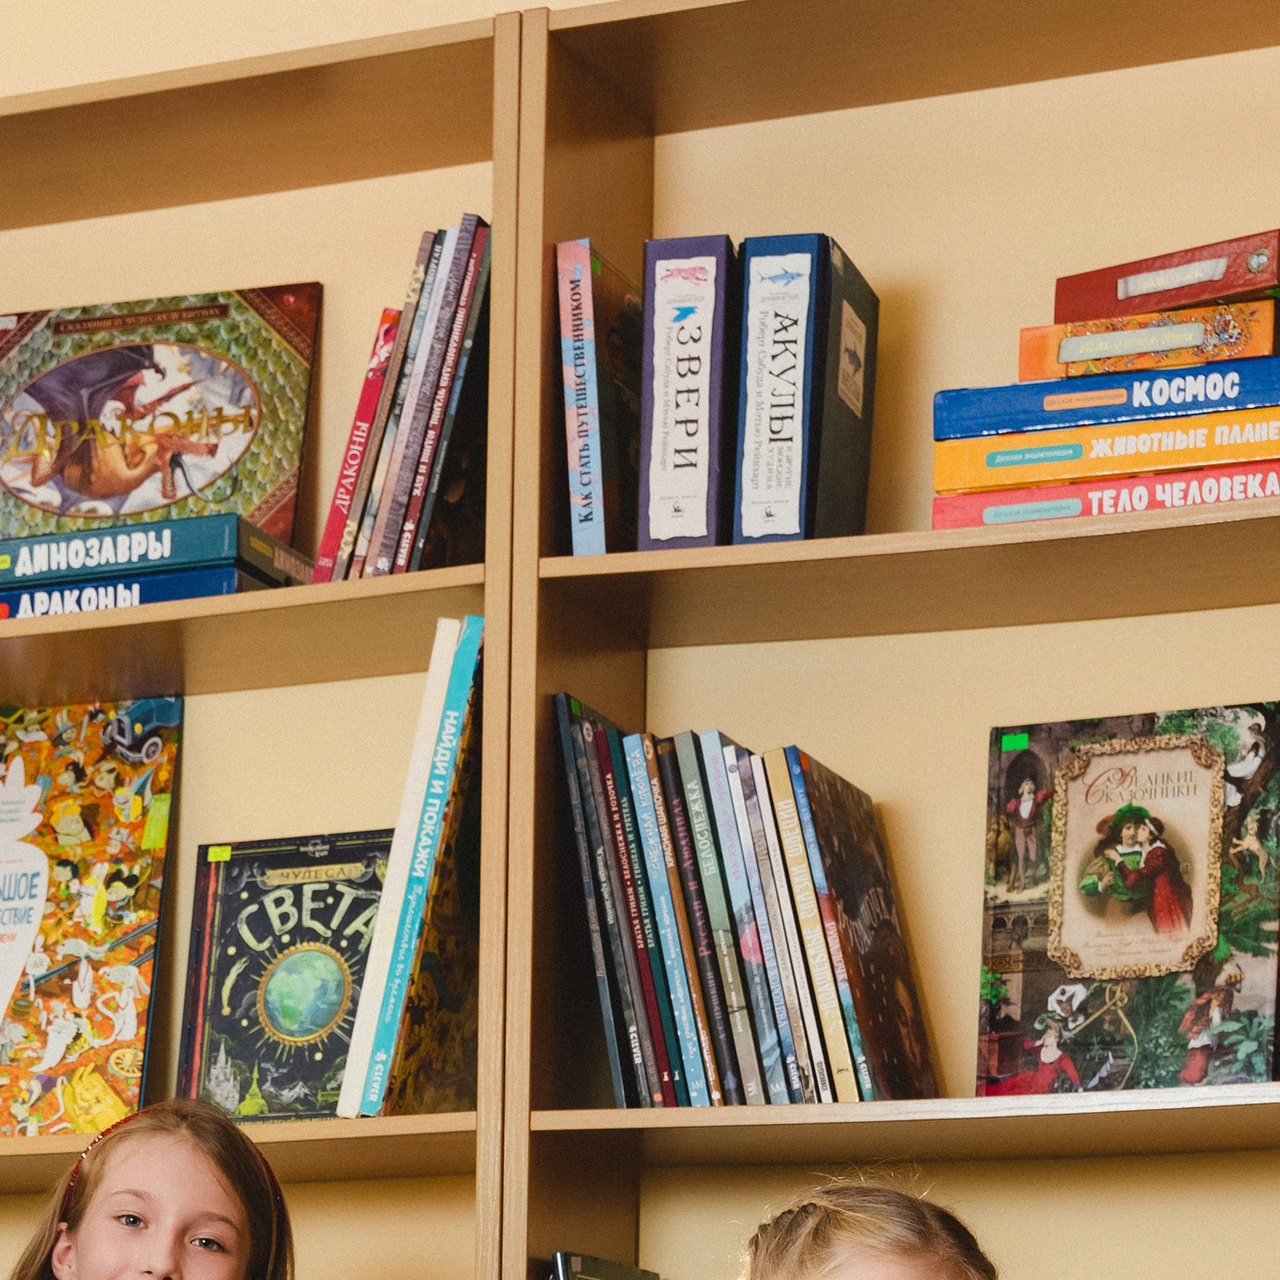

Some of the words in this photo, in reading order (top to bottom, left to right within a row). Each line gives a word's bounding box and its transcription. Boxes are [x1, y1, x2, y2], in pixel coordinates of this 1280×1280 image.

[673, 326, 702, 471] ЗВЕРИ
[769, 311, 799, 442] АКУЛЫ
[1132, 371, 1240, 408] КОСМОС
[328, 419, 373, 514] ДРАКОНЫ
[1089, 428, 1208, 458] ЖИВОТНЫЕ
[1088, 487, 1149, 516] ТЕЛО
[1156, 471, 1280, 508] ЧЕЛОВЕКА
[15, 528, 172, 577] ДИНОЗАВРЫ
[16, 583, 140, 619] ДРАКОНЫ
[430, 708, 461, 776] НАЙДИ
[429, 779, 446, 795] И
[648, 776, 668, 824] ШАПОЧКА
[409, 797, 442, 879] ПОКАЖИ
[657, 824, 675, 868] КРАСНАЯ
[684, 778, 718, 876] БЕЛОСНЕЖКА
[280, 867, 347, 881] ЧУДЕСА
[236, 882, 381, 952] СВЕТА
[802, 925, 837, 1011] ВОЛШЕБНЫЕ
